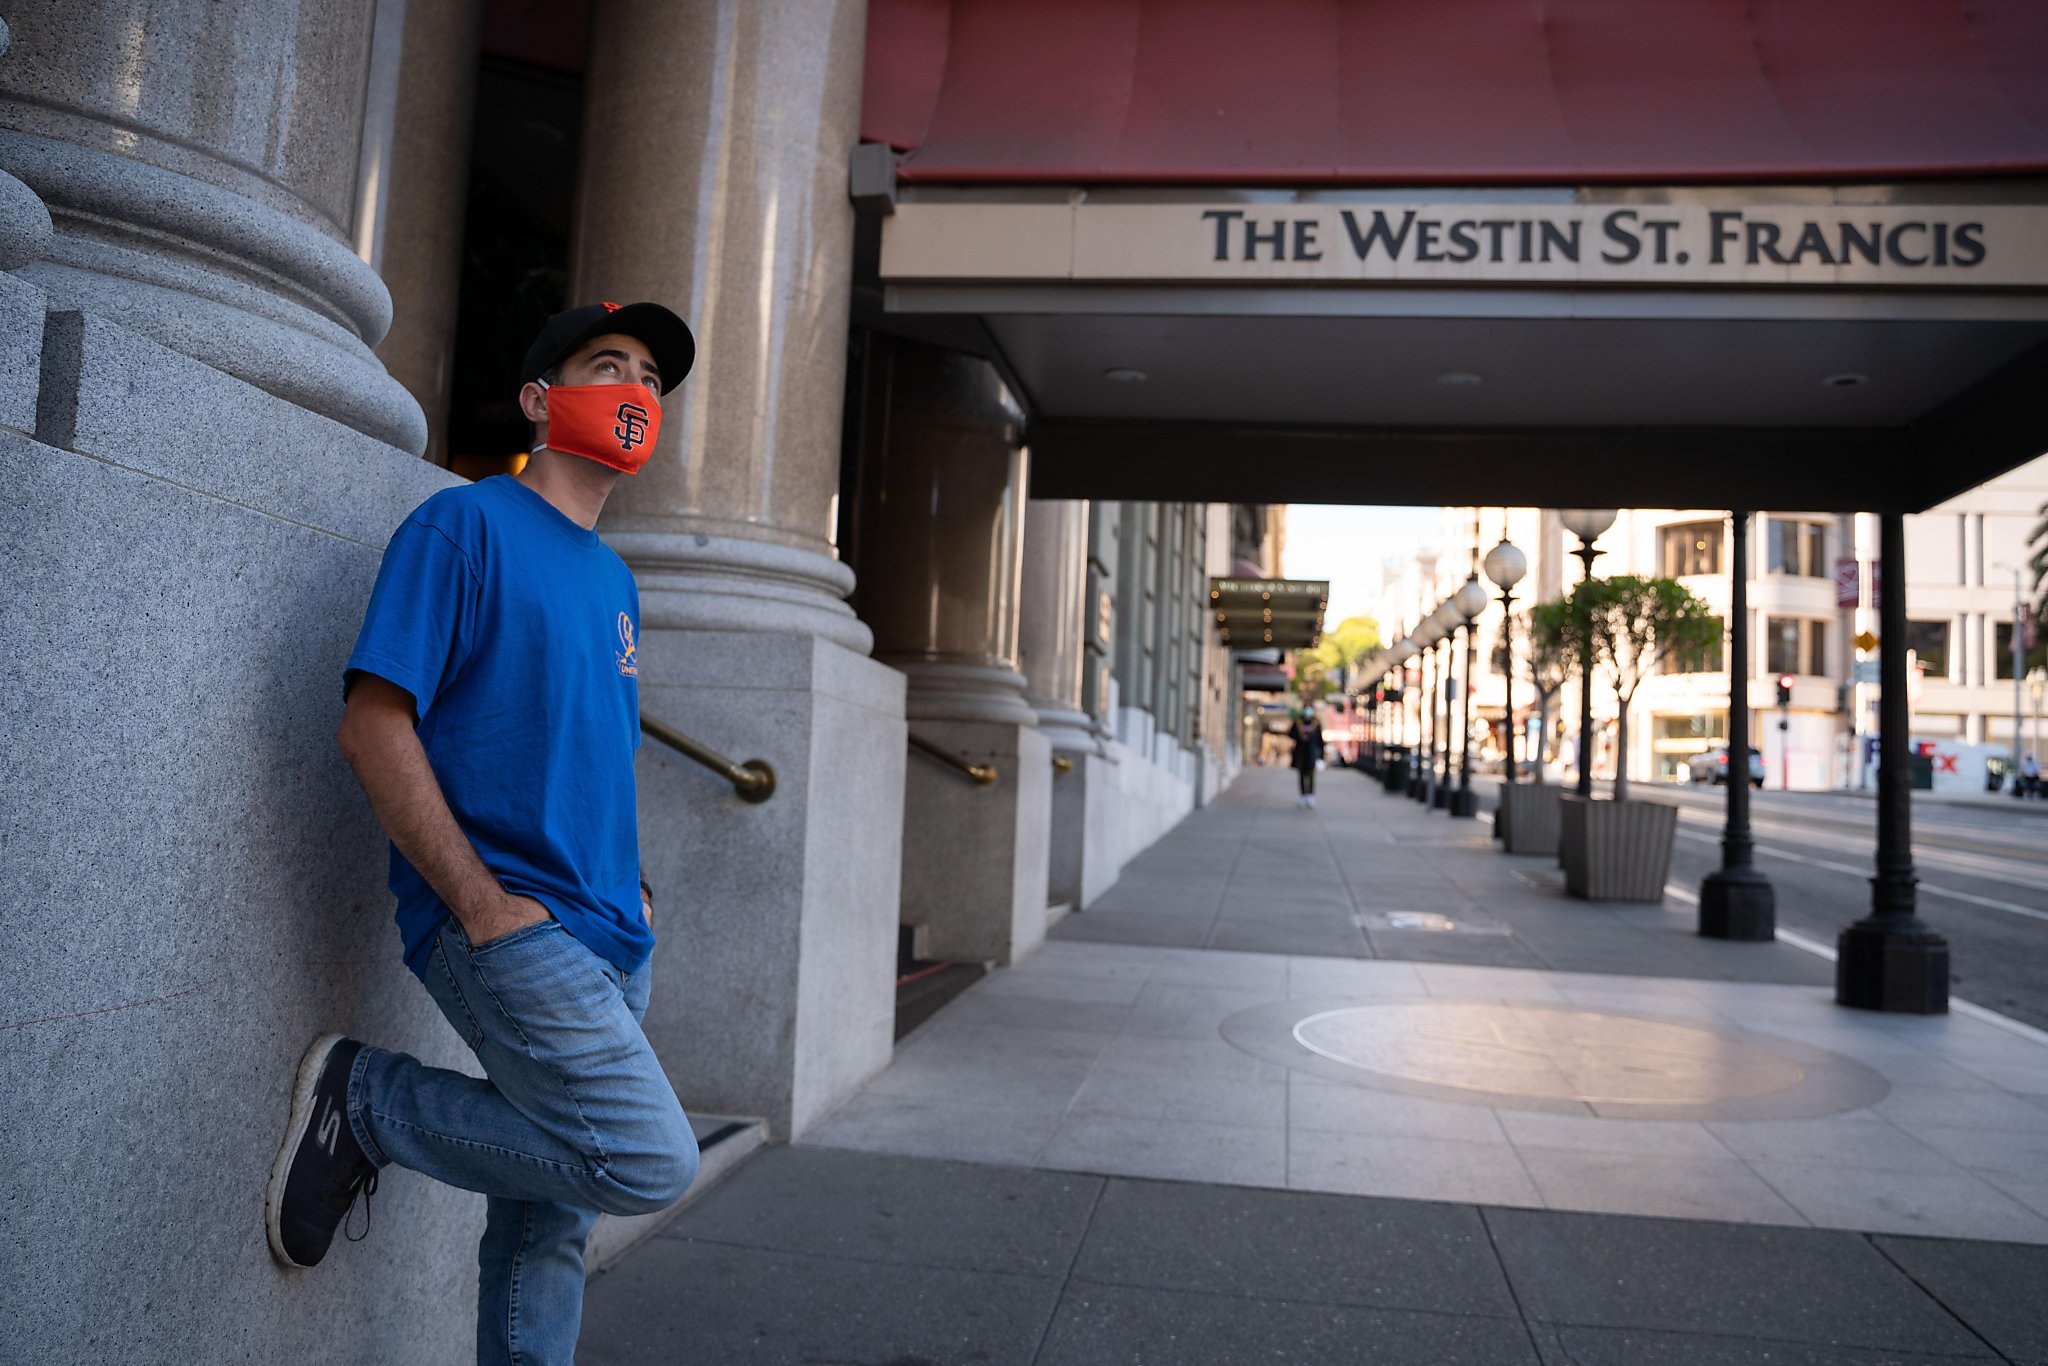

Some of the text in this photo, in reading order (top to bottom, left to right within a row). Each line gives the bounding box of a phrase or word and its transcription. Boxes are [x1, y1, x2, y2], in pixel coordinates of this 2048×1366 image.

[1202, 210, 1987, 267] THE WESTIN ST. FRANCIS
[614, 402, 650, 451] SF
